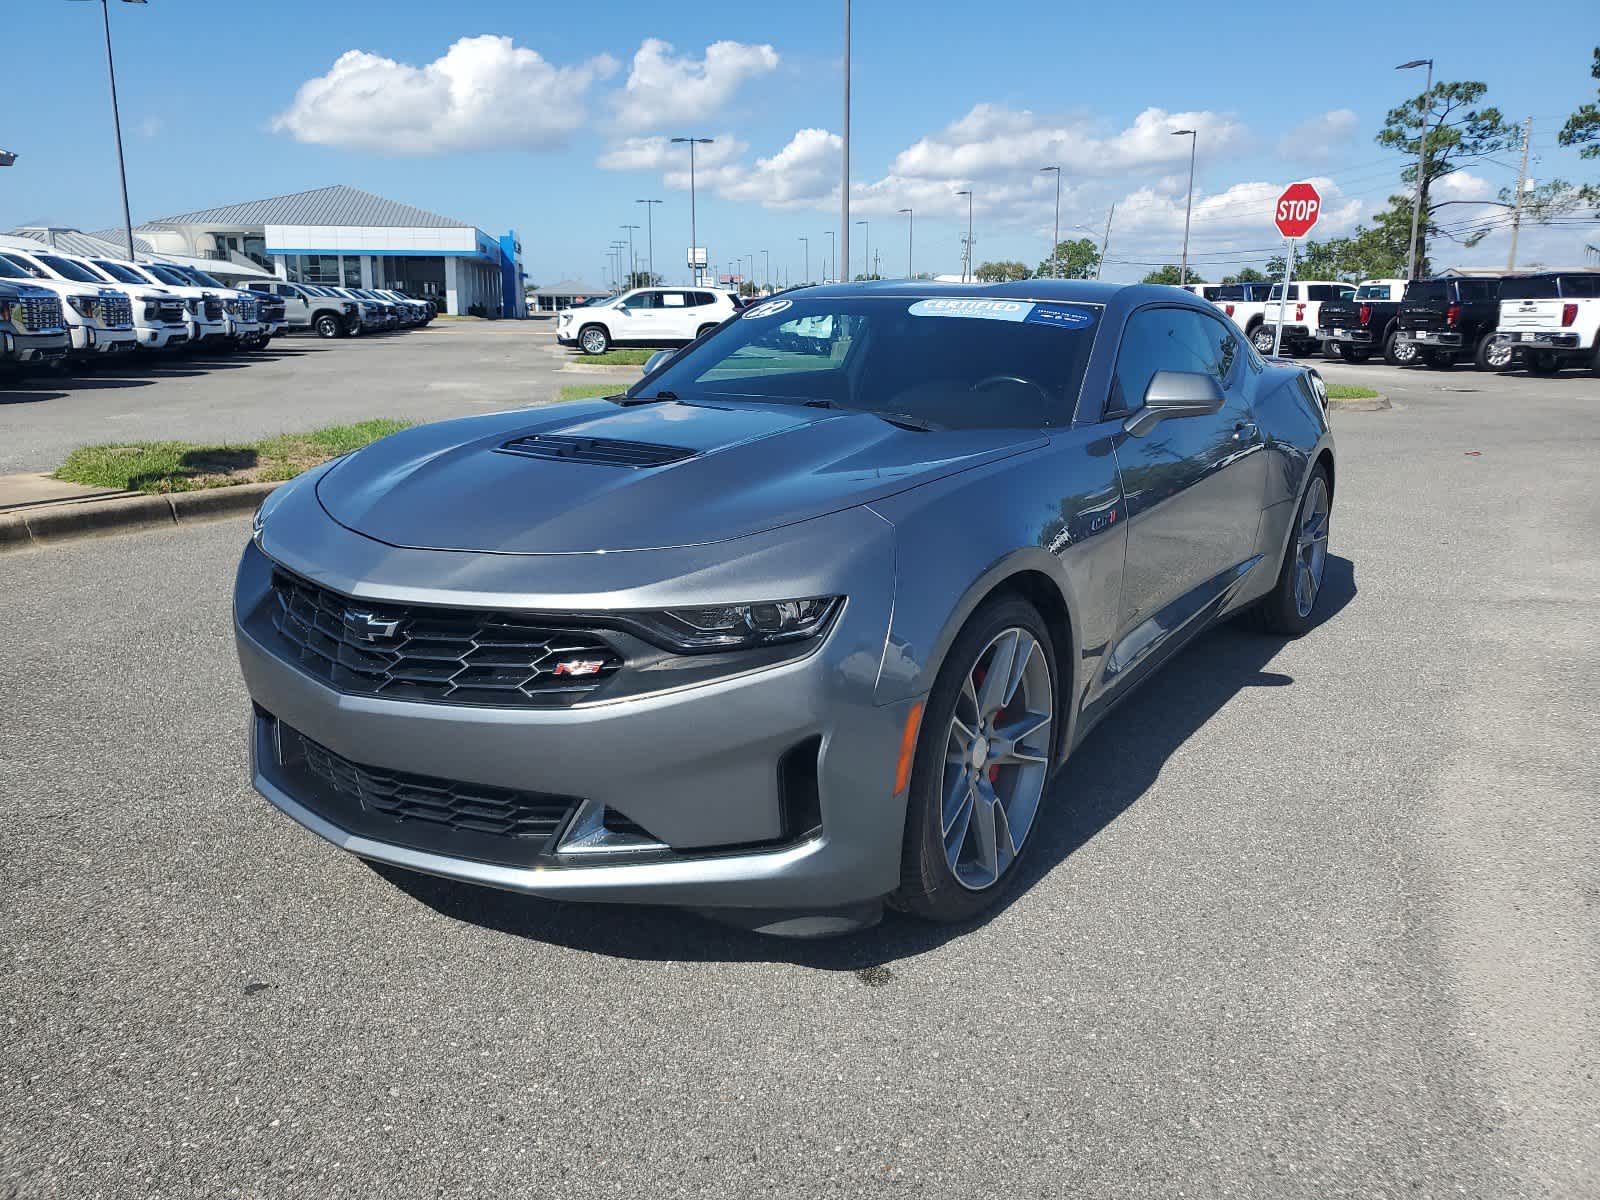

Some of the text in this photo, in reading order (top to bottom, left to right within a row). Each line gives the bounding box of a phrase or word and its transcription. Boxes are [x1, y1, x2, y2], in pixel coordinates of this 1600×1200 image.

[1277, 200, 1318, 221] STOP
[923, 299, 1021, 313] CERTIFIED
[552, 660, 604, 676] RS
